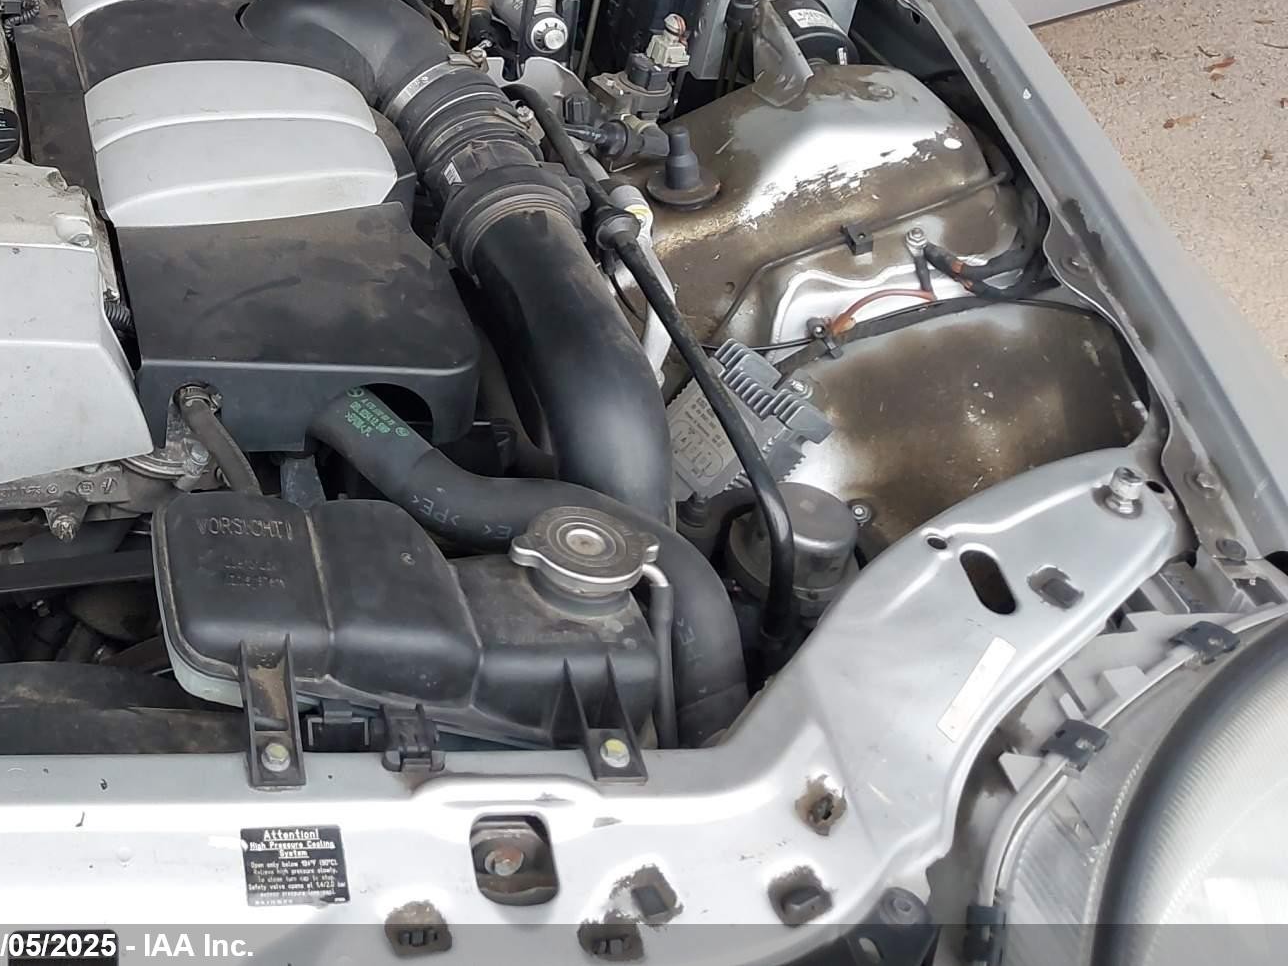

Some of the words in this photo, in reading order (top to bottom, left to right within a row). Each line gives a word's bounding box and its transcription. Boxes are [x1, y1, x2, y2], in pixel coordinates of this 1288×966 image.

[263, 829, 319, 841] Attention!
[249, 841, 266, 851] High
[269, 841, 304, 850] Pressure
[279, 849, 309, 858] System
